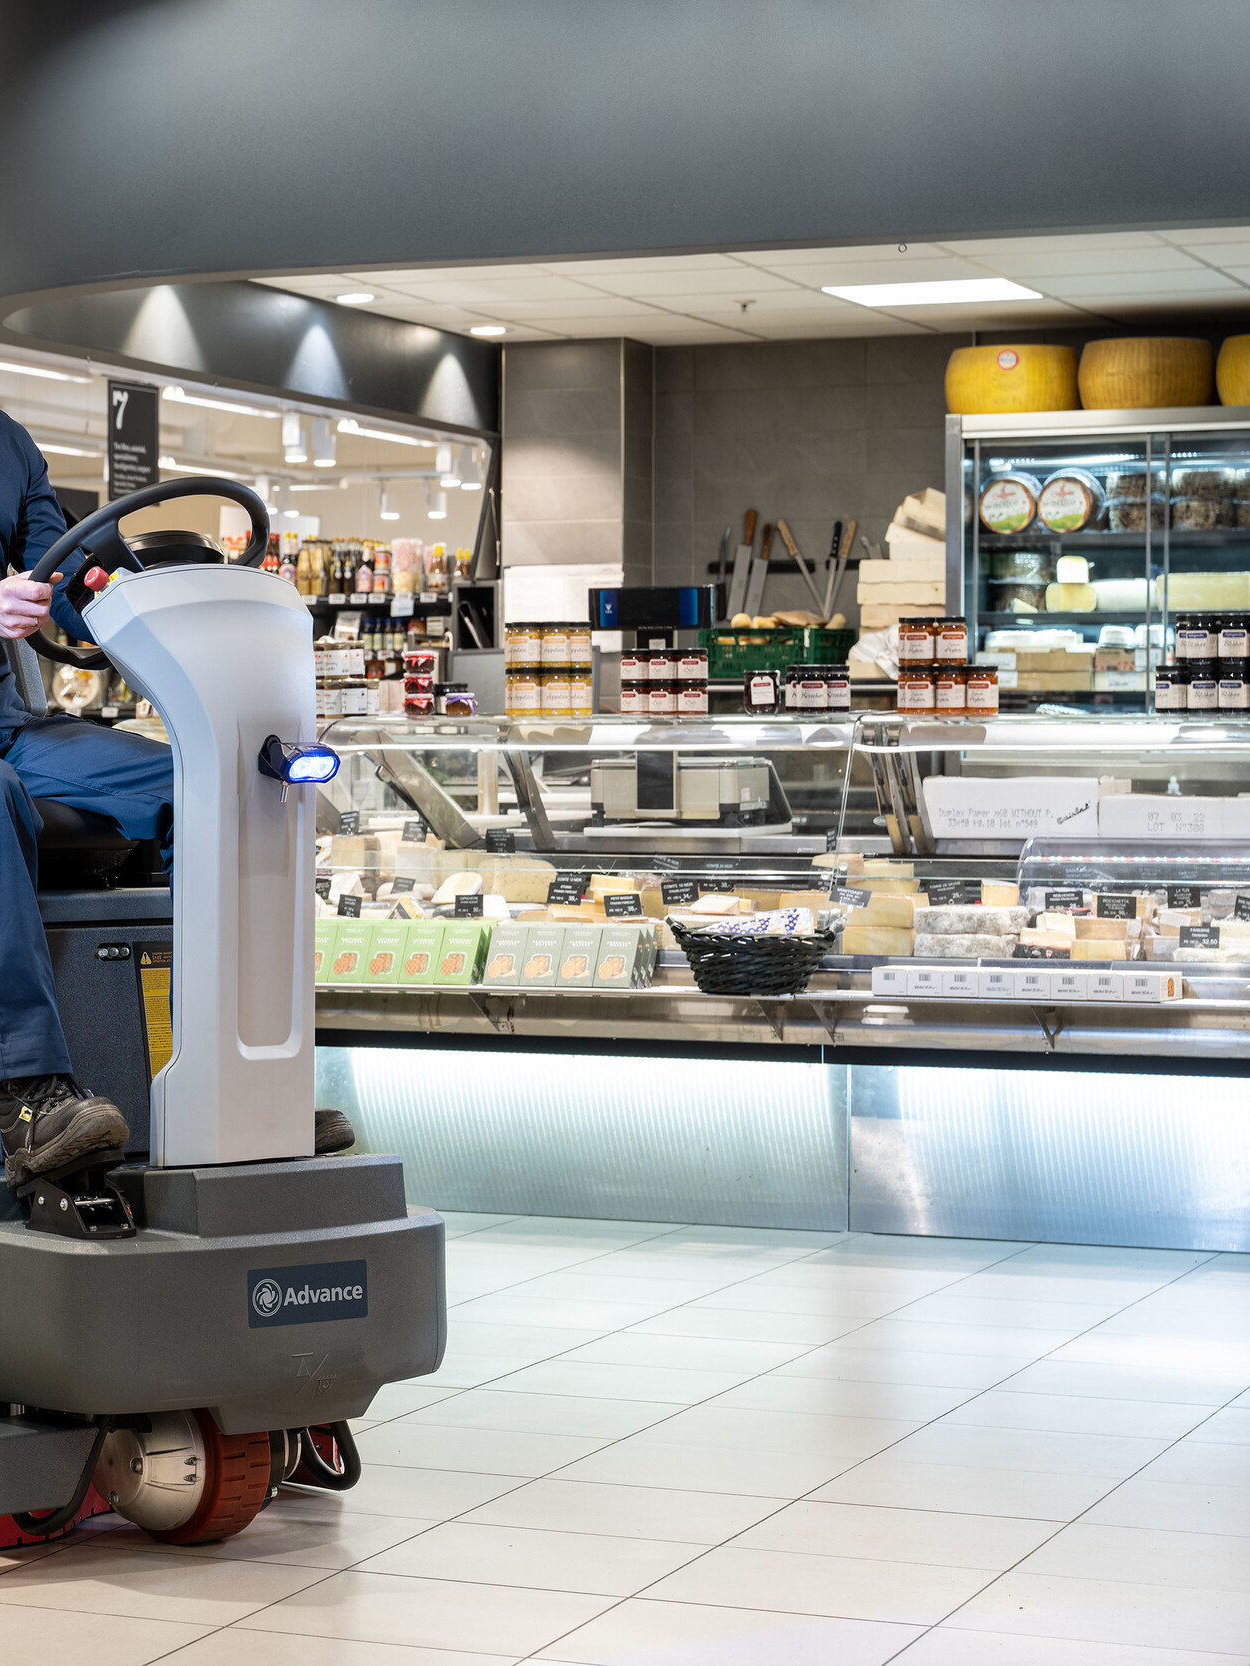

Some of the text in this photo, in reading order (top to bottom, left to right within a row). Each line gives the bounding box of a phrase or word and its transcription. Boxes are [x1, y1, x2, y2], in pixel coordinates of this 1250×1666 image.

[113, 390, 129, 430] 7
[1011, 808, 1041, 818] WITHOUT
[1147, 822, 1164, 832] LOT
[283, 1284, 363, 1306] Advance
